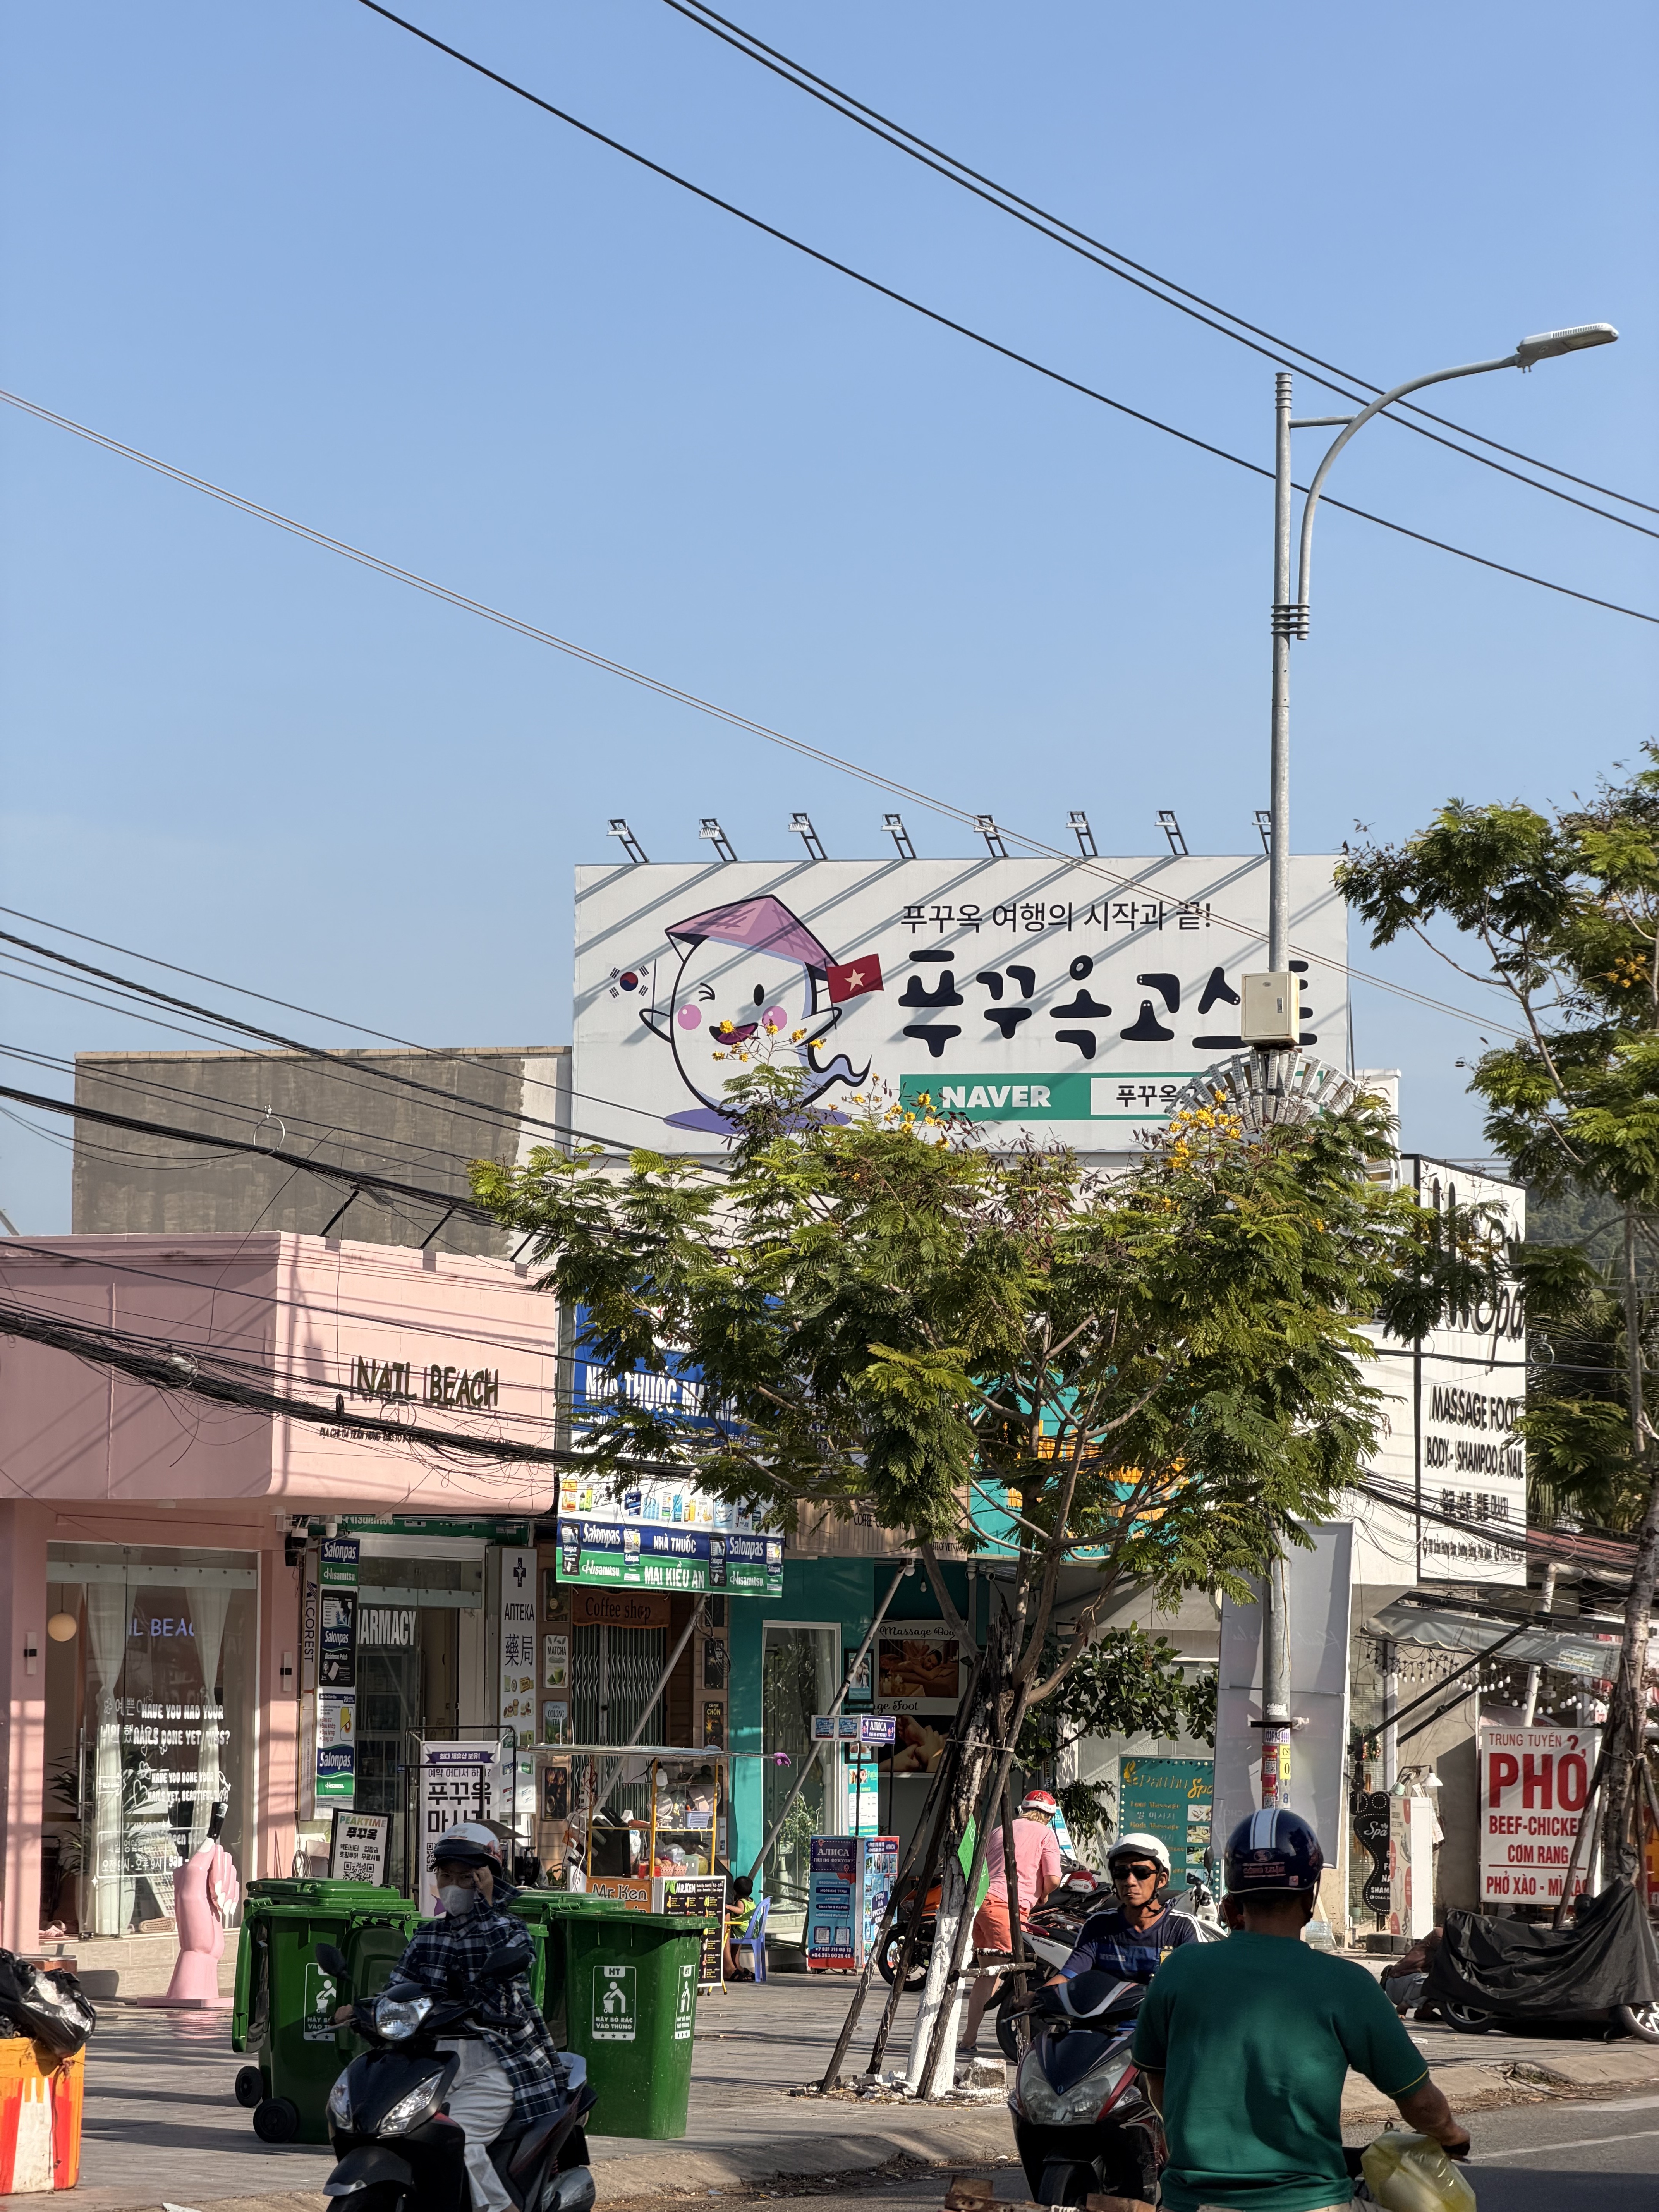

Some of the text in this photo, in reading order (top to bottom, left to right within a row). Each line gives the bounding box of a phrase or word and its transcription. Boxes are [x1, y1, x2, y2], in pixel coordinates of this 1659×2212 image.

[901, 902, 1211, 933] 푸꾸옥 여행의 시작과 끝!
[942, 1085, 1051, 1108] NAVER
[353, 1355, 500, 1407] NAIL BEACH
[1431, 1385, 1487, 1430] MASSAGE
[1425, 1436, 1449, 1468] BODY
[1456, 1441, 1498, 1476] SHAMPOO
[1506, 1448, 1524, 1479] NAIL
[583, 1523, 764, 1559] Salonpas NHÀ THUỐC Salonpas
[324, 1541, 357, 1562] Salonpas
[323, 1567, 356, 1581] Hisamitsu
[582, 1559, 764, 1589] Hisamitsu MAI KIỀU AN Hisamitsu
[504, 1602, 535, 1621] АПТЕКА
[585, 1597, 651, 1625] Coffee shop
[357, 1609, 417, 1645] ARMACY
[879, 1626, 932, 1638] Massage
[325, 1630, 349, 1645] Salonpas
[505, 1633, 534, 1667] 藥局
[547, 1646, 567, 1656] MATCHA
[142, 1704, 223, 1719] HAVE YOU HAD YOUR
[548, 1710, 564, 1718] OOLONG
[869, 1721, 887, 1731] АЛИСА
[161, 1730, 183, 1745] DONE
[1489, 1733, 1523, 1746] TRUNG
[320, 1752, 351, 1770] Salonpas
[151, 1772, 214, 1783] HAVE YOU DONE YOUR
[428, 1768, 469, 1777] 예약 어디서
[1489, 1735, 1587, 1812] PHỞ
[428, 1782, 492, 1805] 푸꾸옥
[339, 1815, 387, 1827] PEAKTIME
[1364, 1821, 1388, 1839] Spa
[1489, 1815, 1582, 1836] BEEF-CHICKE
[346, 1827, 378, 1840] 푸꾸옥
[1508, 1843, 1569, 1864] CƠM RANG
[136, 1858, 149, 1871] 오후
[151, 1858, 162, 1870] 9시
[1486, 1870, 1510, 1894] PHỞ
[1512, 1874, 1536, 1895] XÀO
[617, 1884, 648, 1901] Ken
[872, 1905, 887, 1917] РУССКО
[1031, 1937, 1056, 1948] VISION
